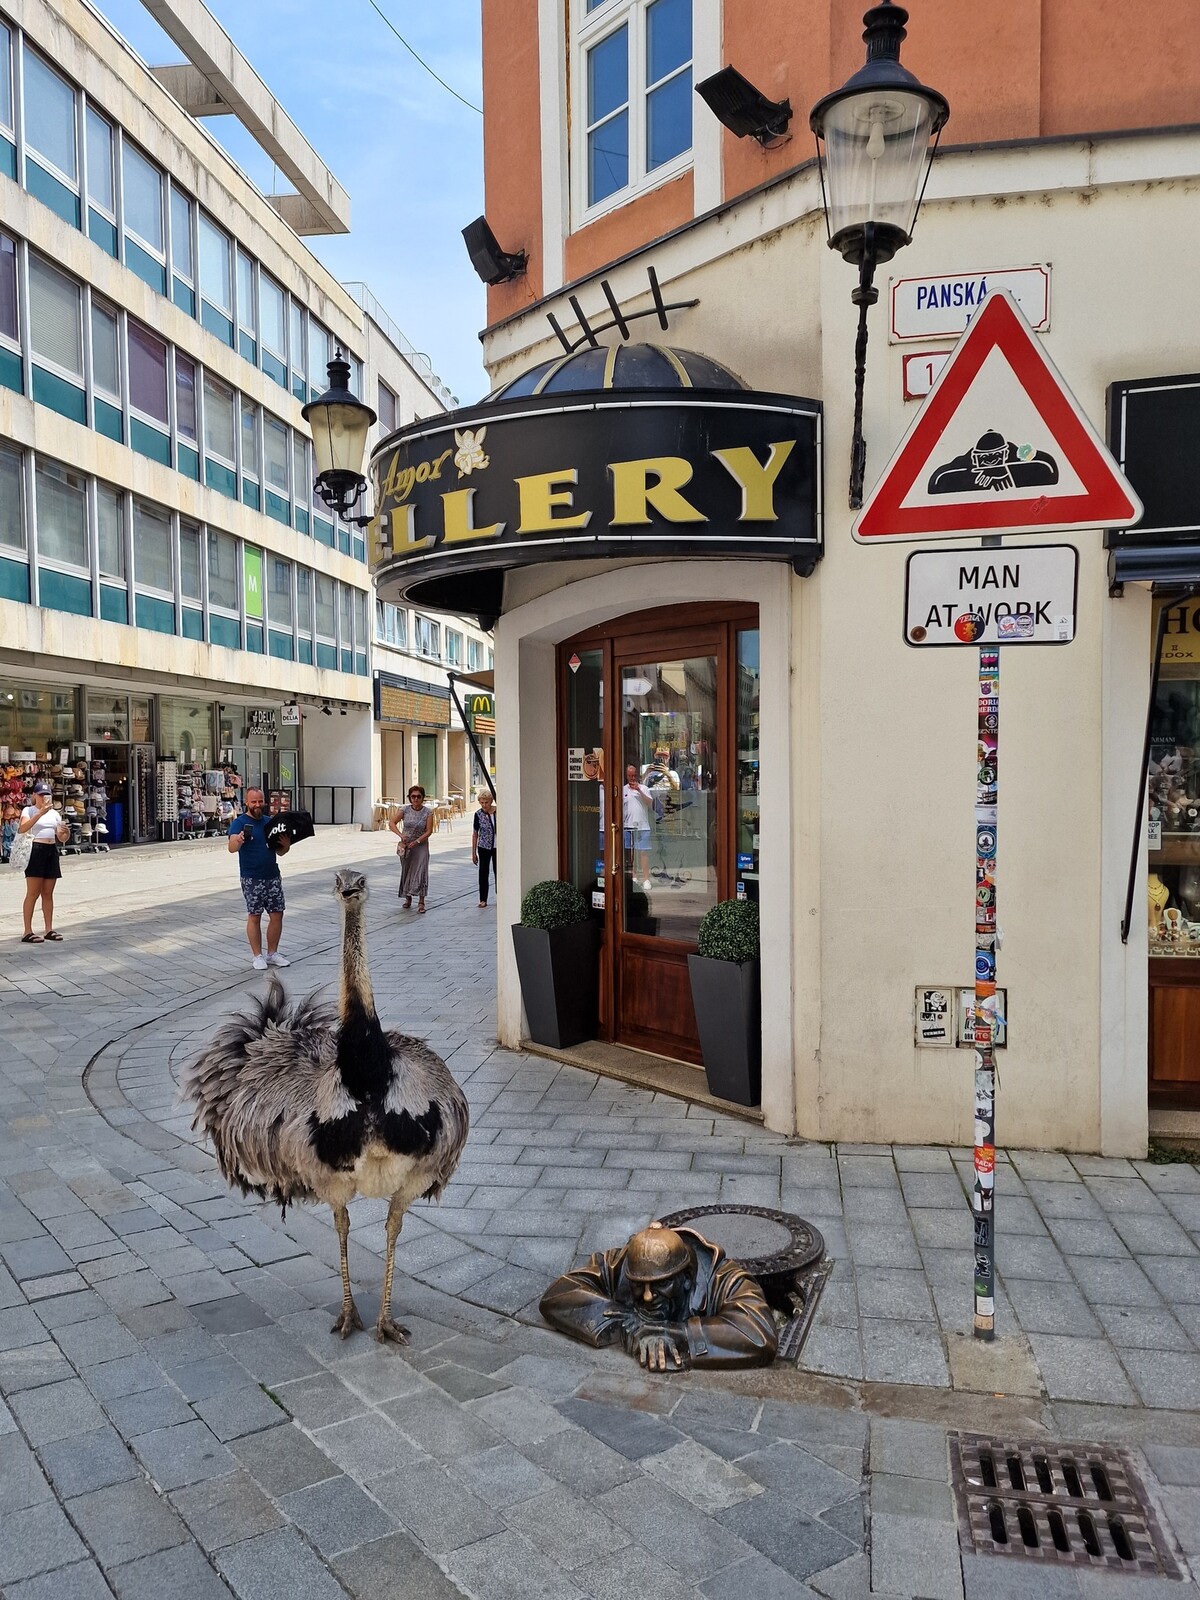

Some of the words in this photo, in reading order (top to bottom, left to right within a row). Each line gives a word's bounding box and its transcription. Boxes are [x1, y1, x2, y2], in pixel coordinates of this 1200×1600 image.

[916, 276, 988, 310] PANSKÁ
[374, 448, 454, 508] Amor
[247, 574, 259, 594] M
[957, 563, 1021, 591] MAN
[924, 603, 959, 629] AT
[258, 710, 277, 724] DELIA
